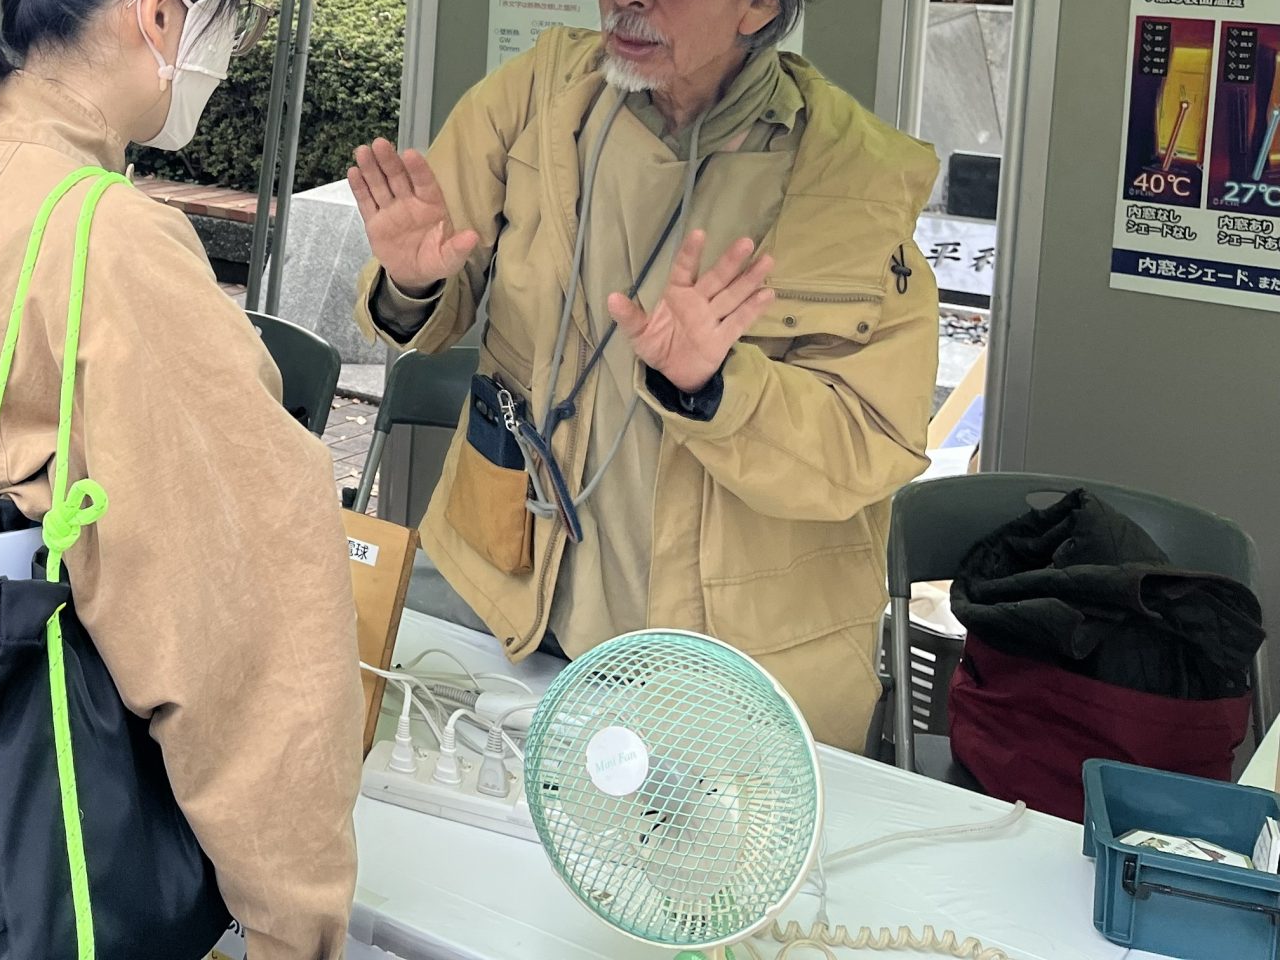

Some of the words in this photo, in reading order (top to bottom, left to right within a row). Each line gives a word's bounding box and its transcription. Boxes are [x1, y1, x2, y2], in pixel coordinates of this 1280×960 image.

[1127, 205, 1182, 224] 内窓なし
[1126, 220, 1198, 241] シェードなし
[1218, 215, 1274, 235] 内窓あり
[1217, 231, 1280, 251] シェードあ
